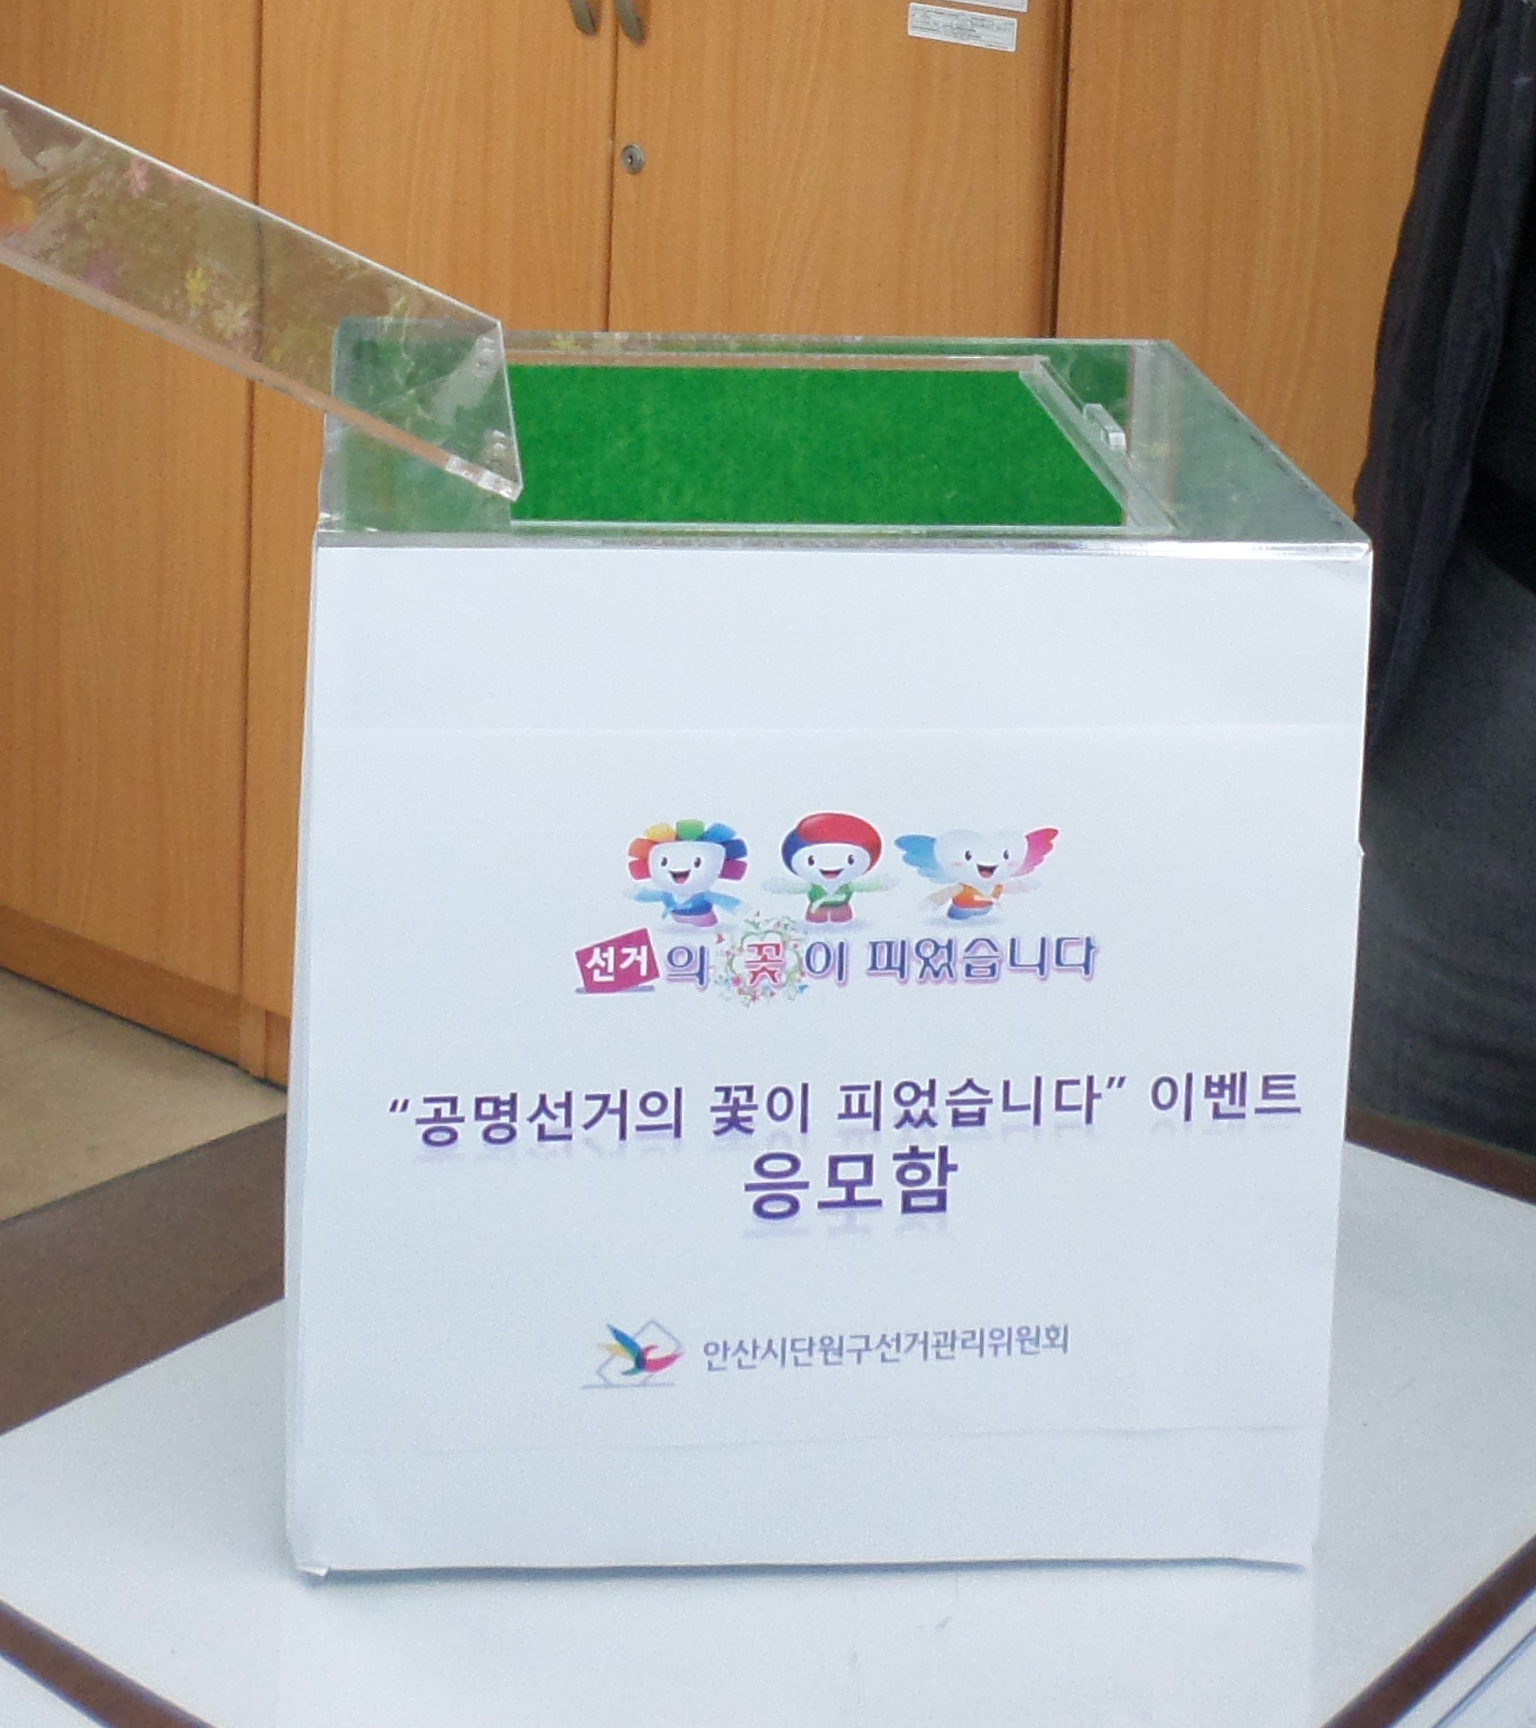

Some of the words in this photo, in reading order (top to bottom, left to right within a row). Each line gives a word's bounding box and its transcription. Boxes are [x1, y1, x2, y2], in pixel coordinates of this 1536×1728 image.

[584, 939, 710, 987] 선거의
[743, 939, 849, 987] 꽃이
[867, 935, 1098, 983] 피었습니다
[709, 1081, 813, 1139] 꽃이
[1149, 1071, 1303, 1122] 이벤트
[742, 1144, 960, 1223] 응모함
[703, 1322, 1071, 1375] 안산시단원구선거관리위원회
